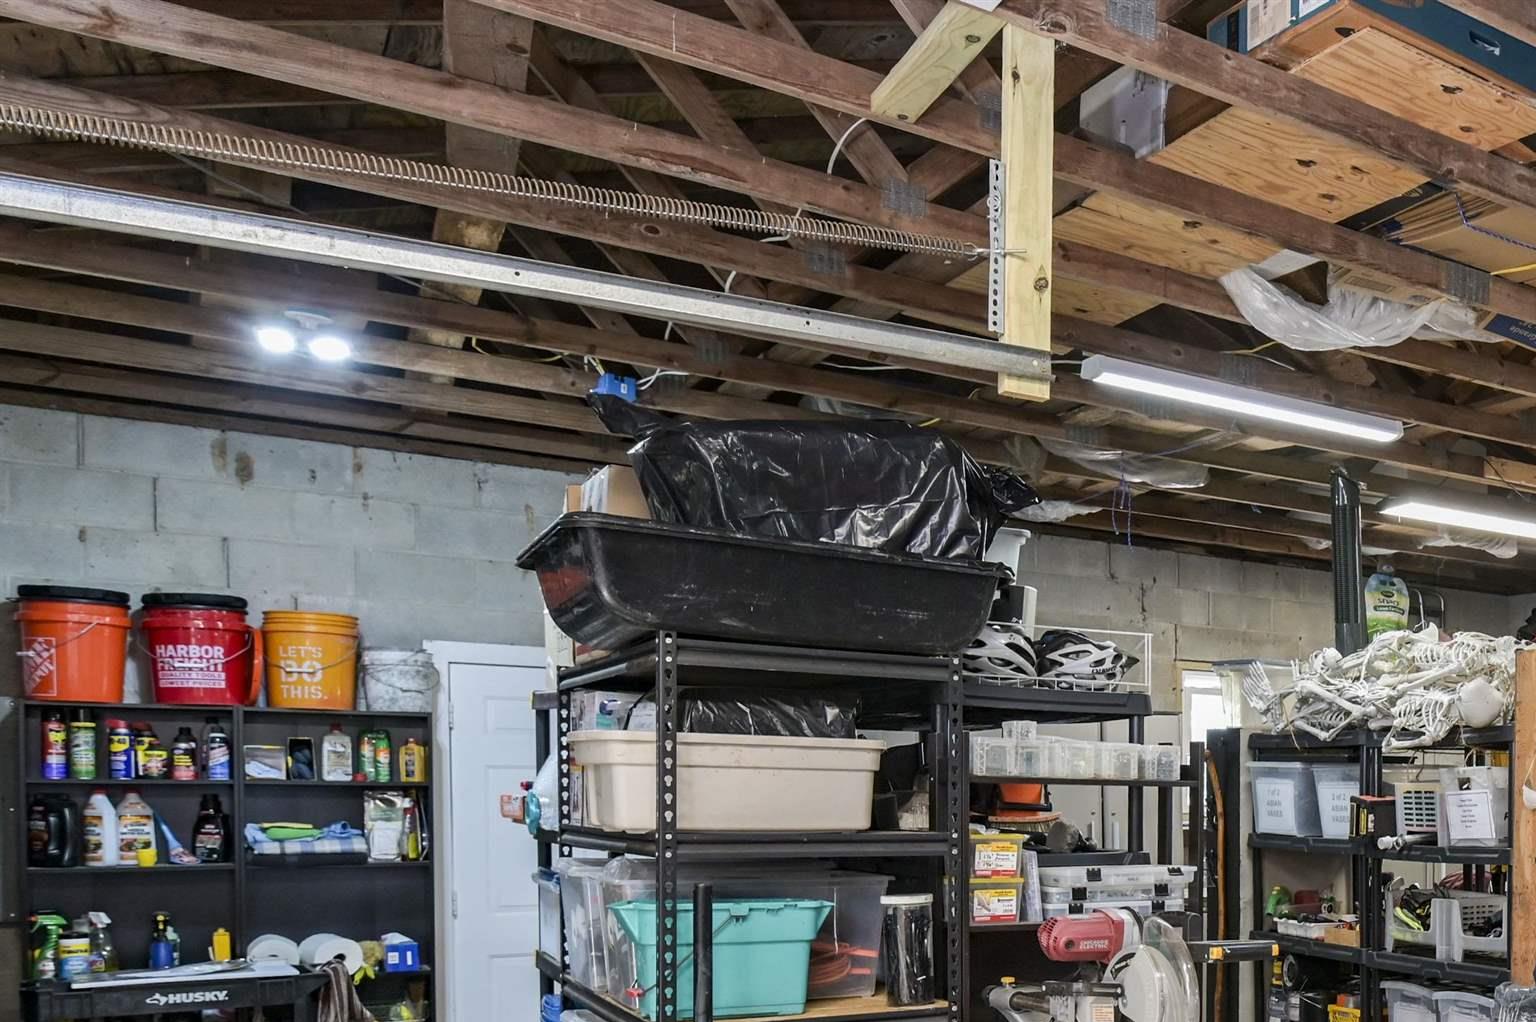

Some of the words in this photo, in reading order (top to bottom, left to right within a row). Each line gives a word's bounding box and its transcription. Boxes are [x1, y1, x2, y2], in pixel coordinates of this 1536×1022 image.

[155, 644, 225, 660] HARBOR
[278, 645, 323, 659] LET'S
[156, 658, 226, 672] FREIGHT
[280, 659, 323, 683] DO
[280, 684, 329, 700] THIS.
